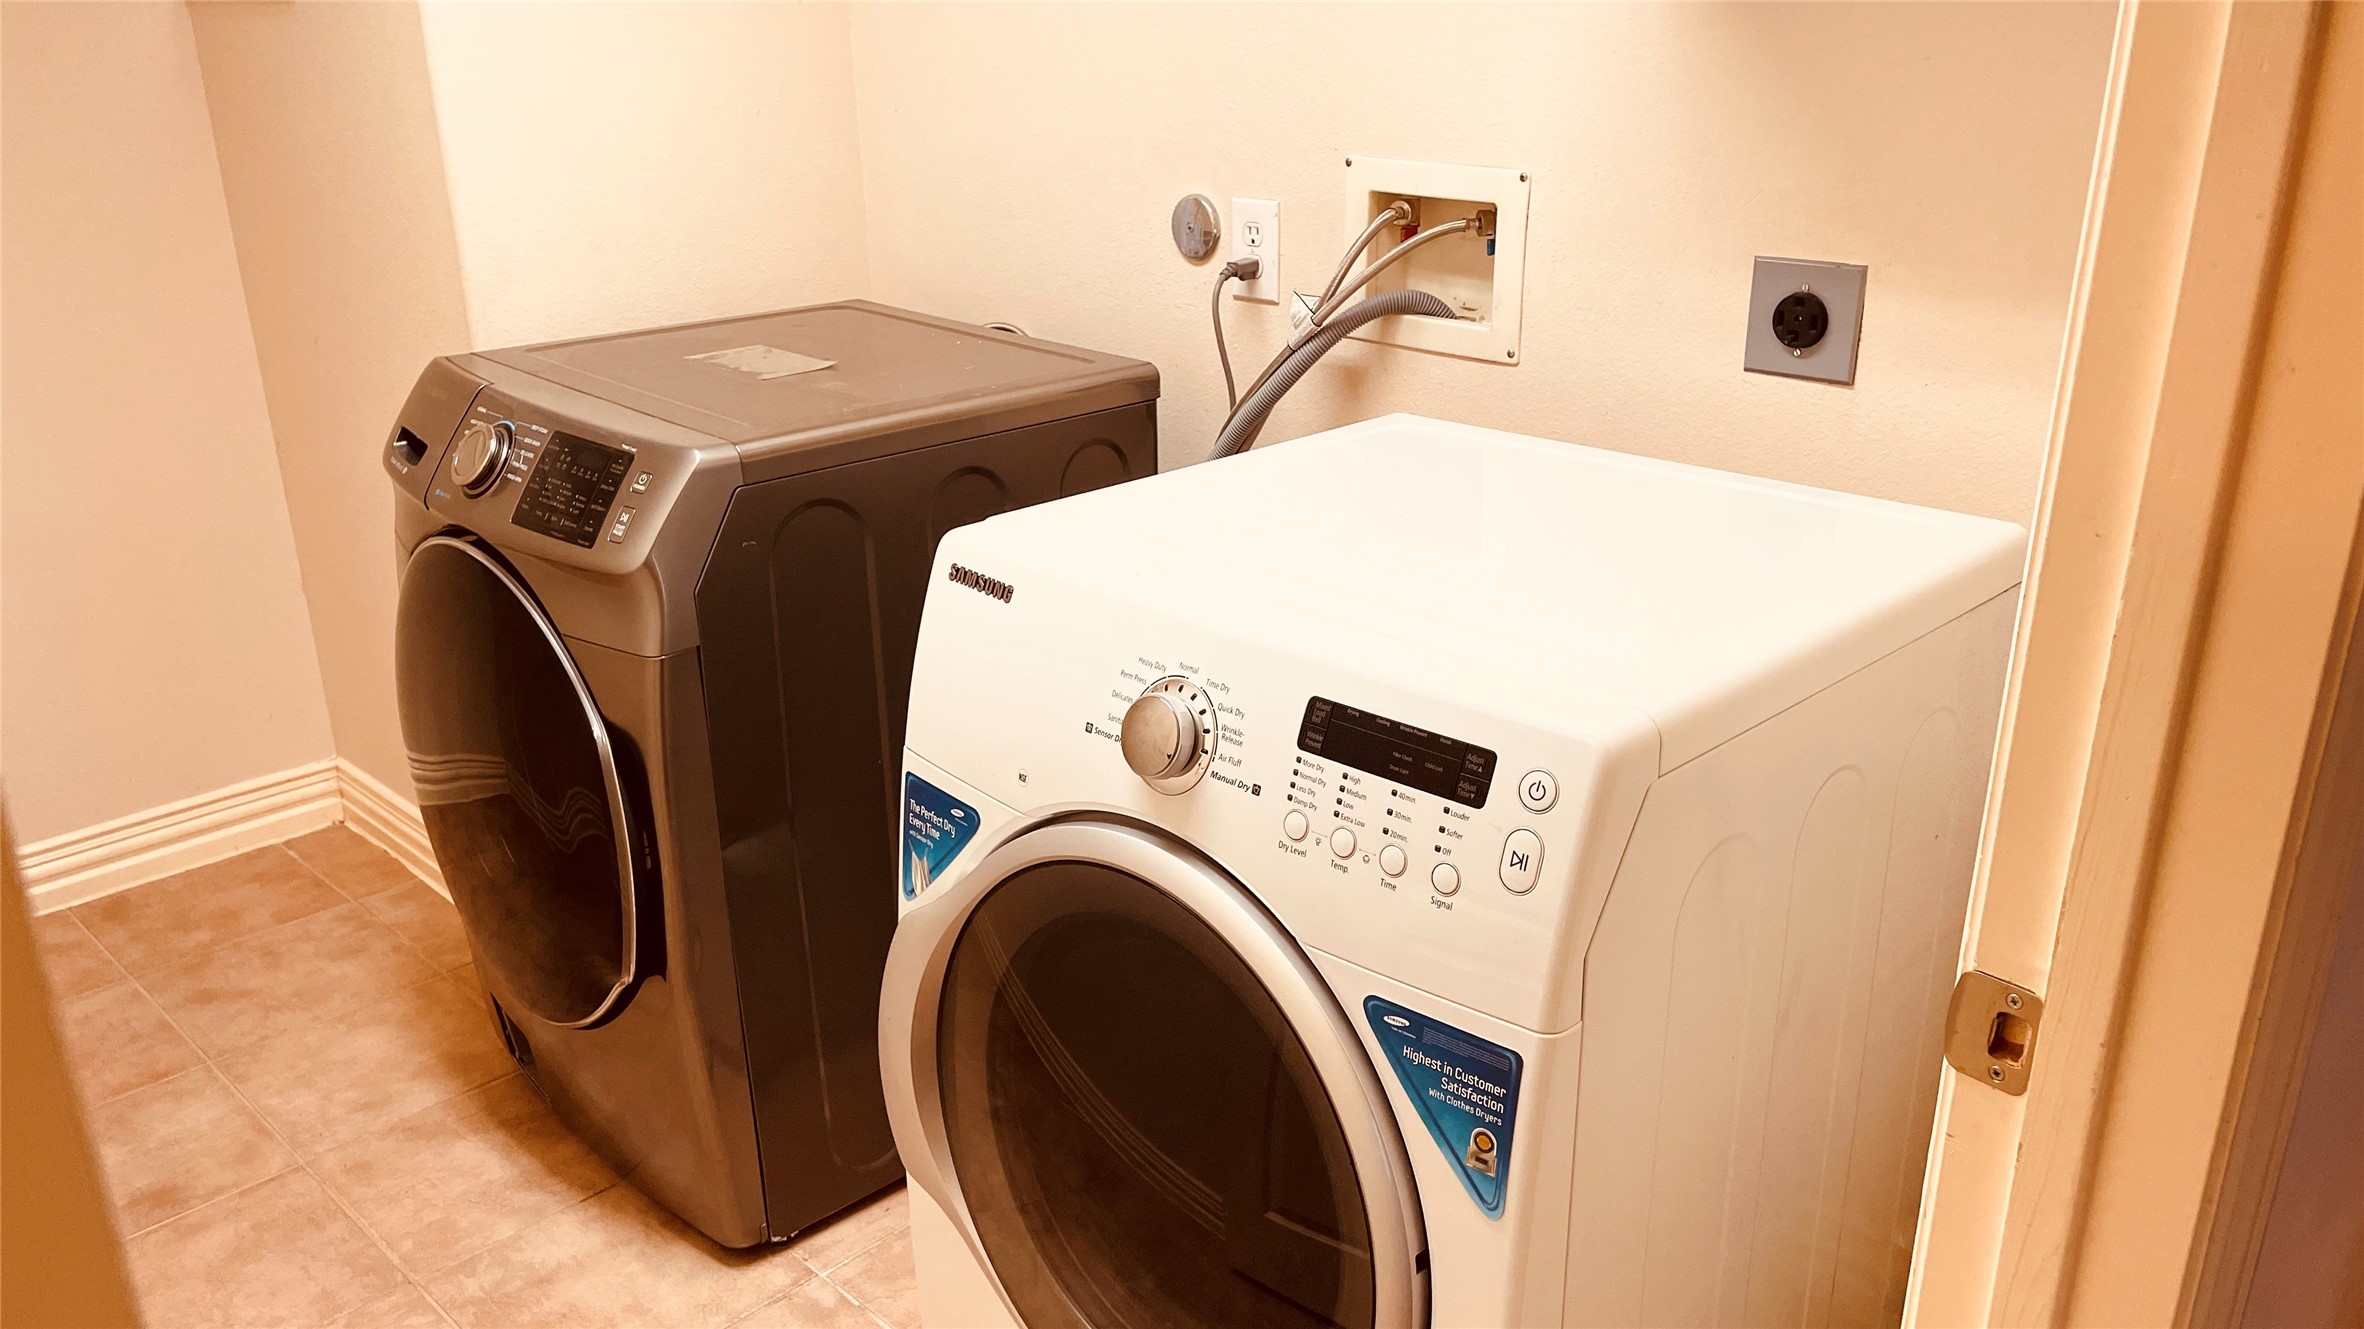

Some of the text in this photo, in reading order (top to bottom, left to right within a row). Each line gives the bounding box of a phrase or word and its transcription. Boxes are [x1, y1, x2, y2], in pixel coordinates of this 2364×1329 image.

[949, 563, 1014, 604] SAMSUNG
[1138, 656, 1167, 673] Heavy Duty
[1179, 662, 1200, 674] Normal
[1120, 670, 1147, 685] Perm Press
[1206, 678, 1230, 694] Time Dry
[1112, 690, 1133, 704] Delicates
[1218, 702, 1245, 720] Quick Dry
[1094, 727, 1113, 739] Sensor
[1221, 733, 1244, 748] Release
[1218, 754, 1242, 768] Air Fluff
[1302, 759, 1325, 774] More Dry
[1465, 761, 1478, 770] Time
[1466, 753, 1485, 765] Adjust
[1210, 770, 1251, 793] Manual Dry
[1300, 771, 1327, 788] Normal Dry
[1349, 775, 1361, 786] High
[1458, 780, 1476, 792] Adjust
[1296, 784, 1316, 798] Less Dry
[1346, 788, 1367, 801] Medium
[1457, 788, 1471, 798] Time
[1293, 796, 1317, 812] Damp Dry
[1343, 800, 1354, 810] Low
[910, 798, 920, 814] The
[921, 805, 943, 829] Perfect
[944, 819, 956, 838] Dry
[1340, 813, 1365, 828] Extra Low
[1450, 810, 1470, 822] Louder
[909, 813, 926, 835] Every
[926, 822, 940, 840] Time
[1446, 828, 1463, 840] Softer
[1278, 840, 1307, 858] Dry Level
[1442, 847, 1452, 856] Off
[1330, 859, 1350, 874] Temp.
[1380, 878, 1397, 892] Time
[1430, 896, 1453, 911] Signal
[1402, 1045, 1442, 1073] Highest
[1443, 1062, 1453, 1077] in
[1454, 1068, 1507, 1098] Customer
[1441, 1078, 1504, 1114] Satisfaction
[1428, 1088, 1502, 1126] With Clothes Dryers
